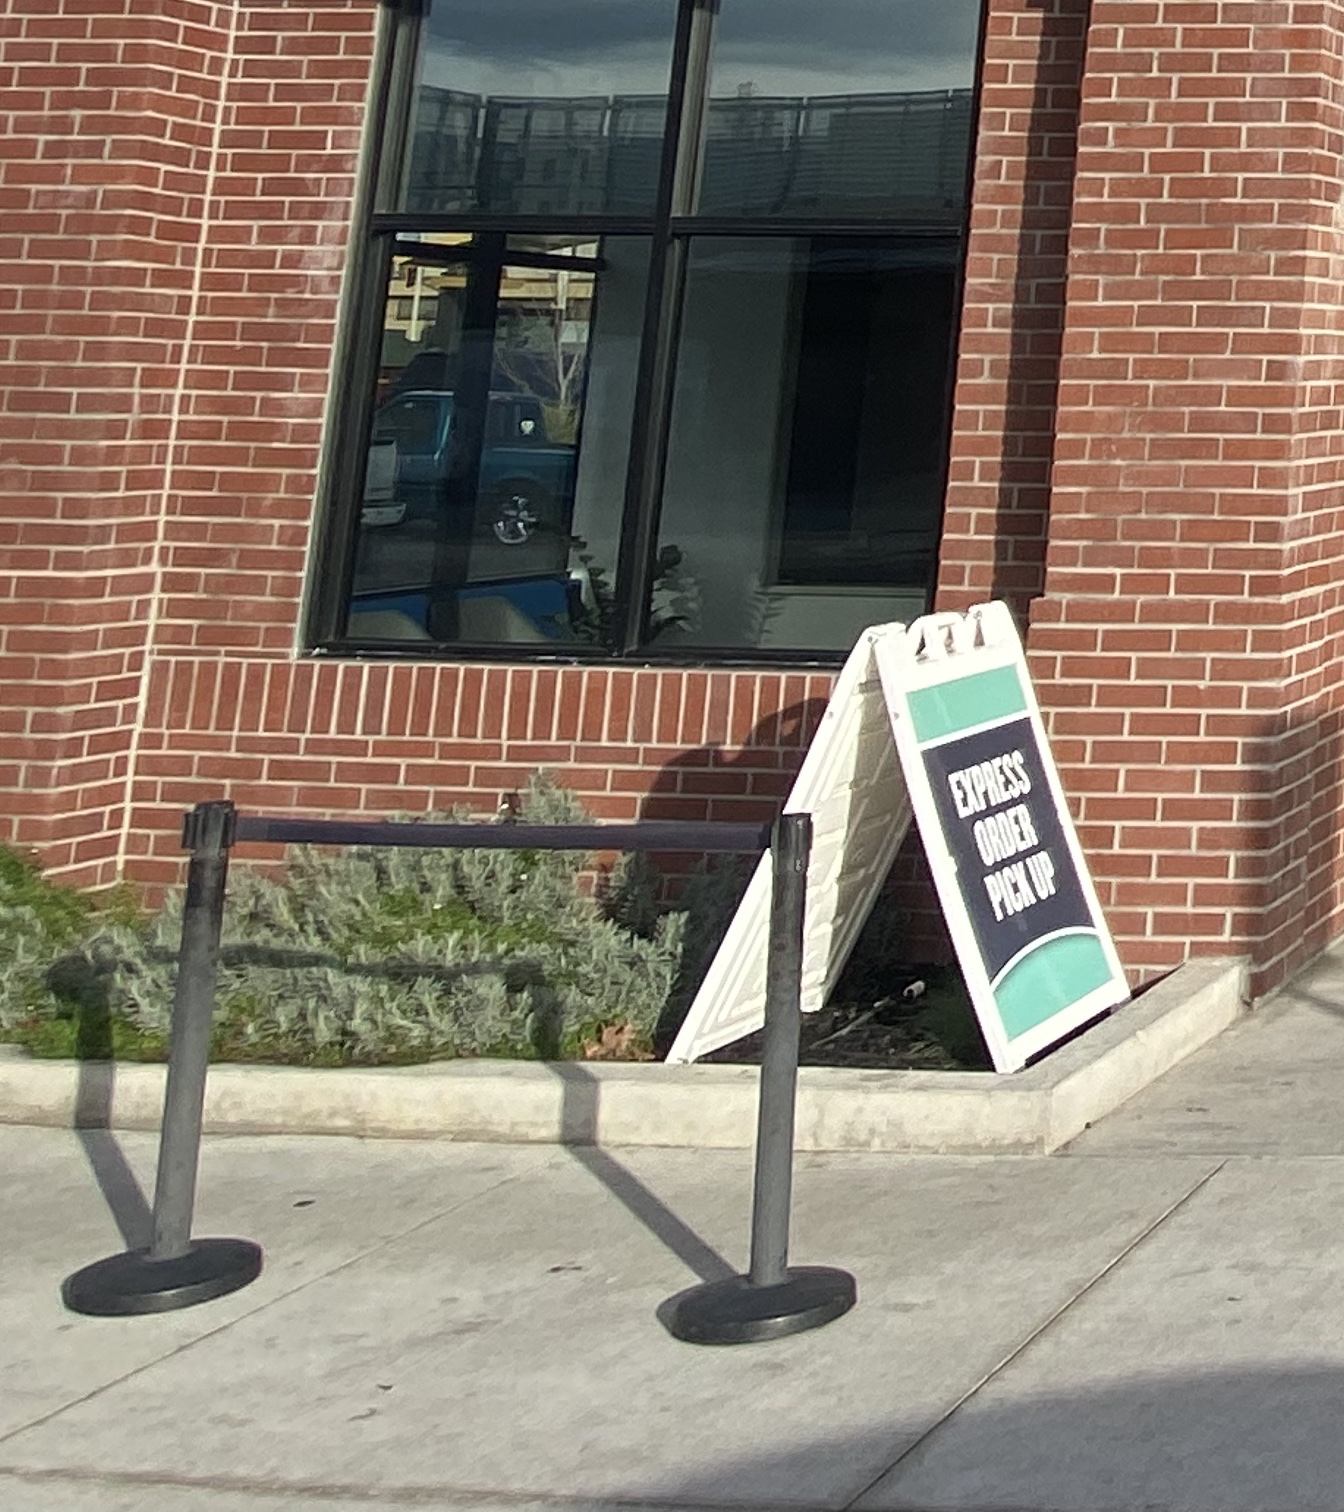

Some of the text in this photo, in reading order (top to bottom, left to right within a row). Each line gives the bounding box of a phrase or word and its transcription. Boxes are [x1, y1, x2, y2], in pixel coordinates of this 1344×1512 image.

[947, 749, 1032, 820] EXPRESS
[973, 803, 1039, 867] ORDER
[983, 850, 1056, 922] PICK UP
